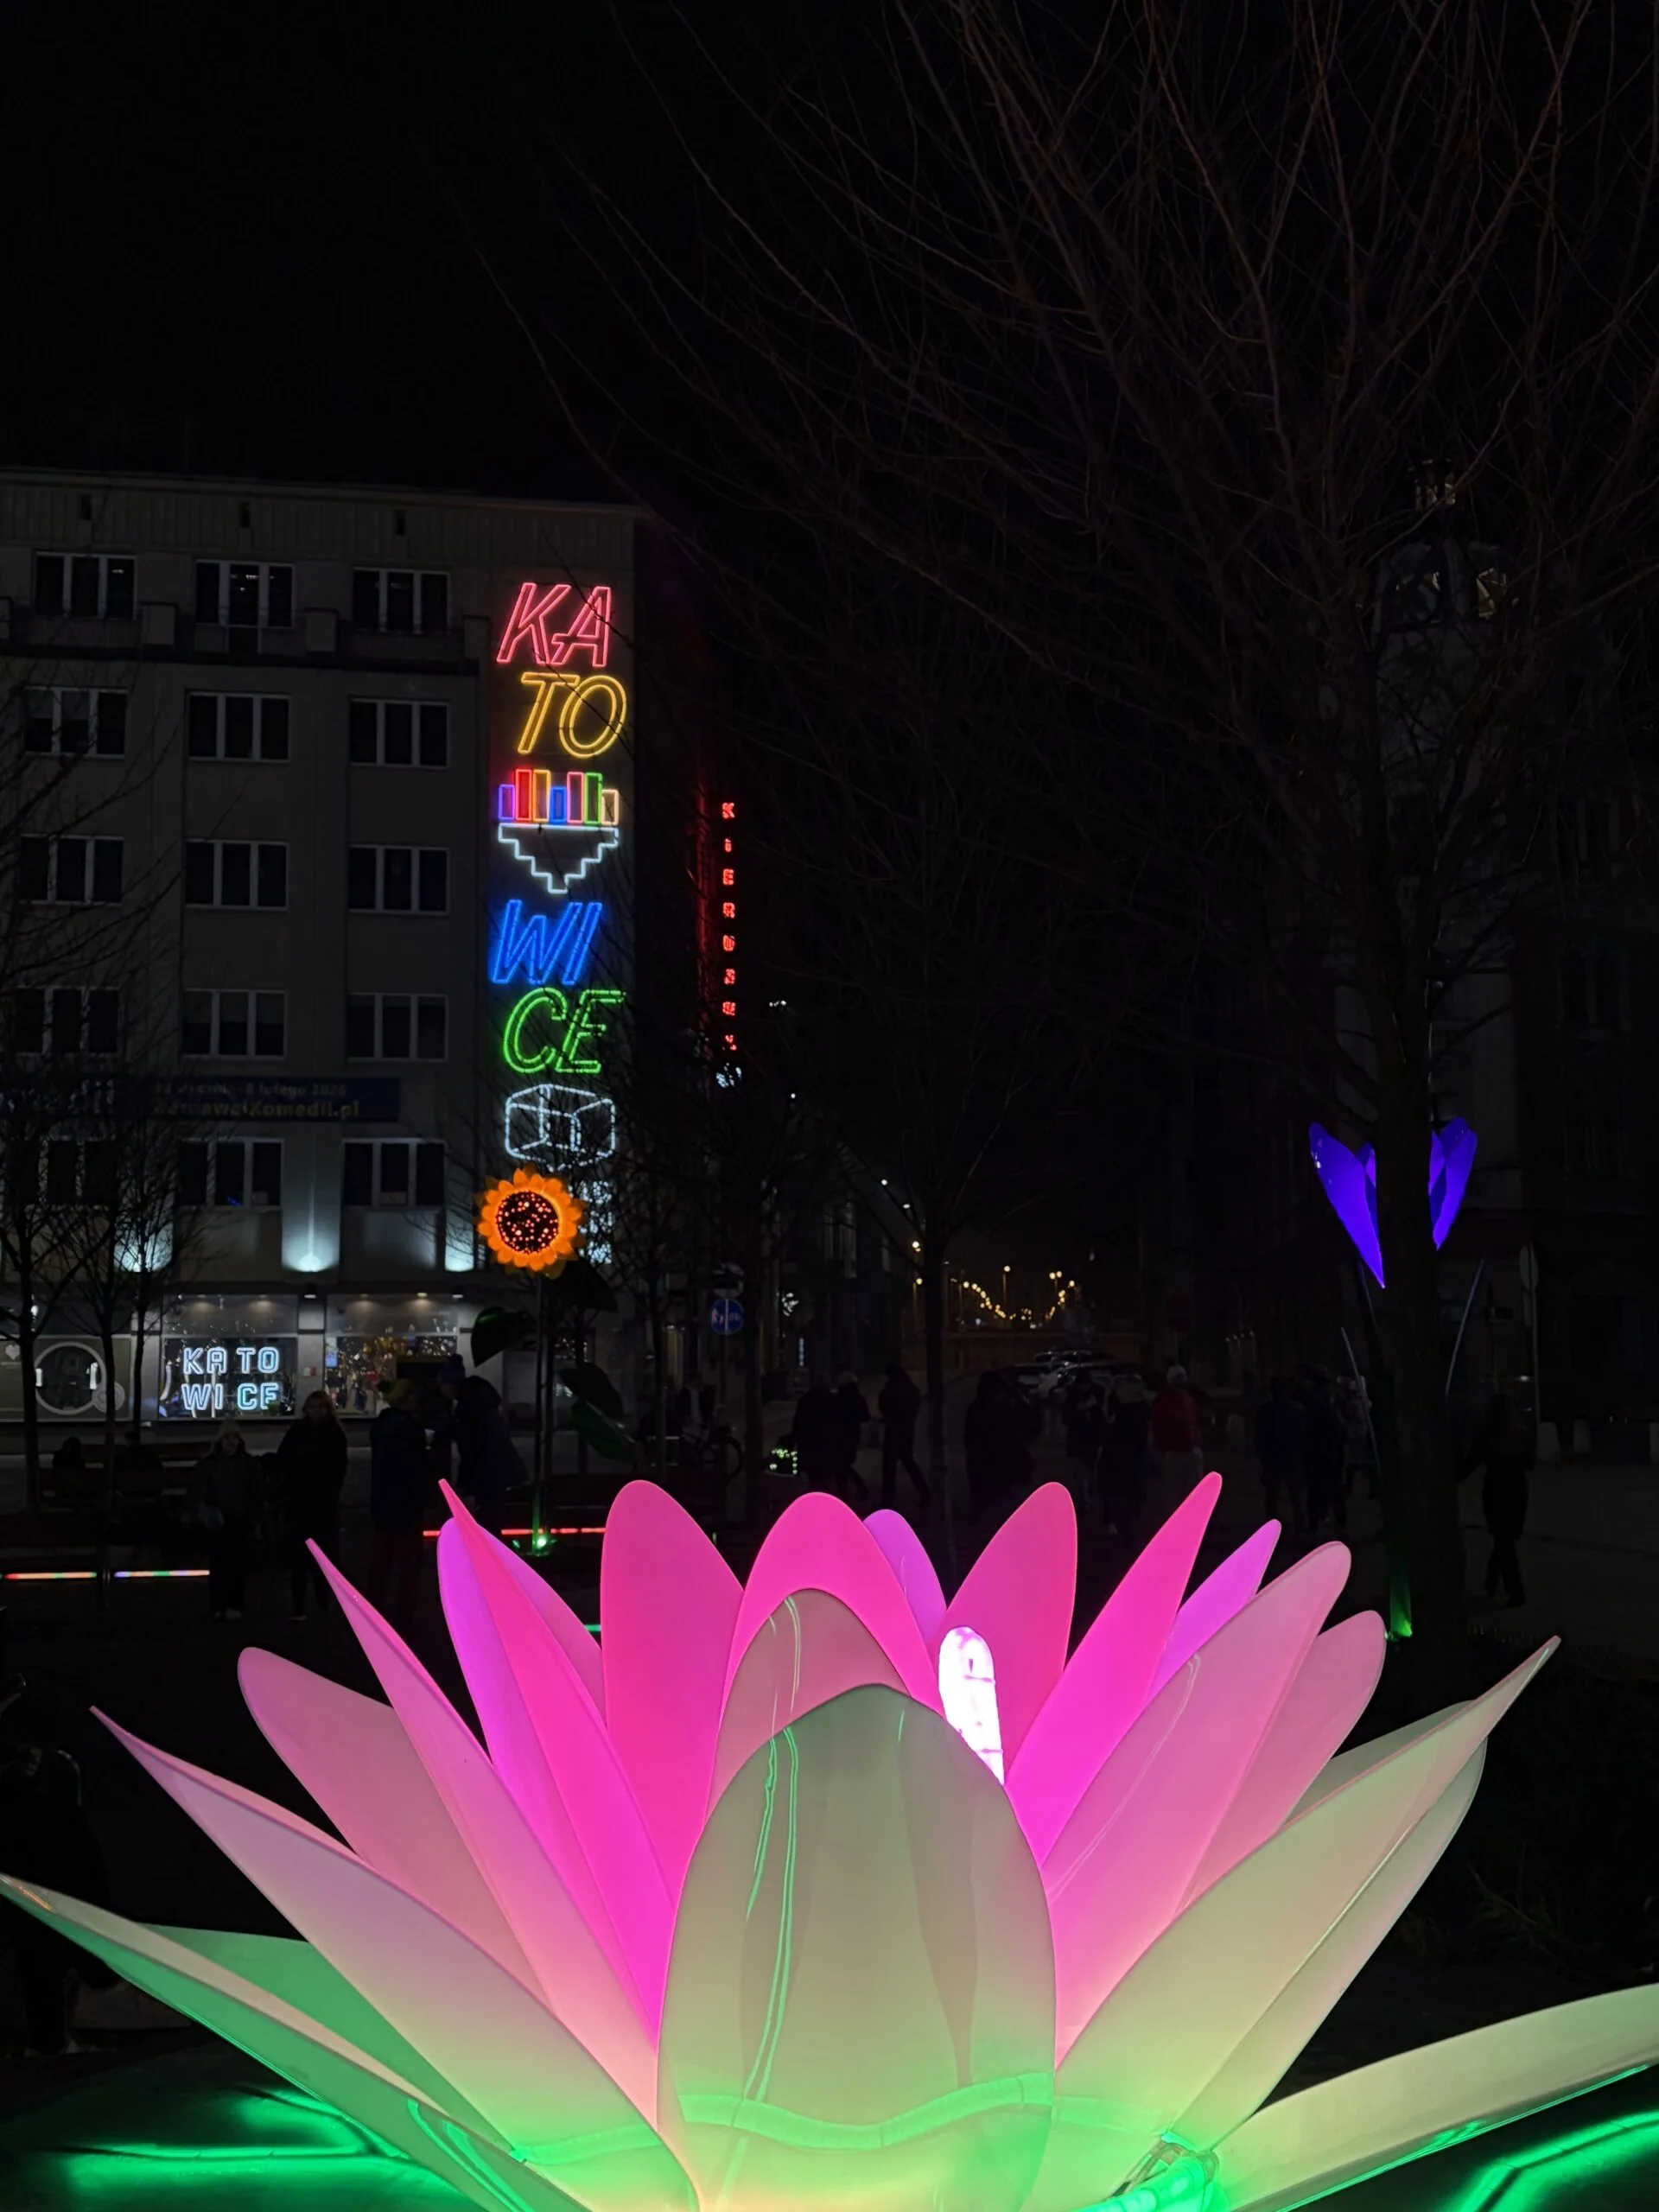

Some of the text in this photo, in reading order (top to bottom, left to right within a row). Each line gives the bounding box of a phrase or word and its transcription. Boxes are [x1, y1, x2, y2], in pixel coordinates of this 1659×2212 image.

[495, 582, 612, 668] KA
[517, 671, 627, 759] TO
[492, 899, 603, 985] WI
[503, 987, 627, 1074] CE
[181, 1383, 224, 1411] WI
[183, 1346, 280, 1375] KA TO
